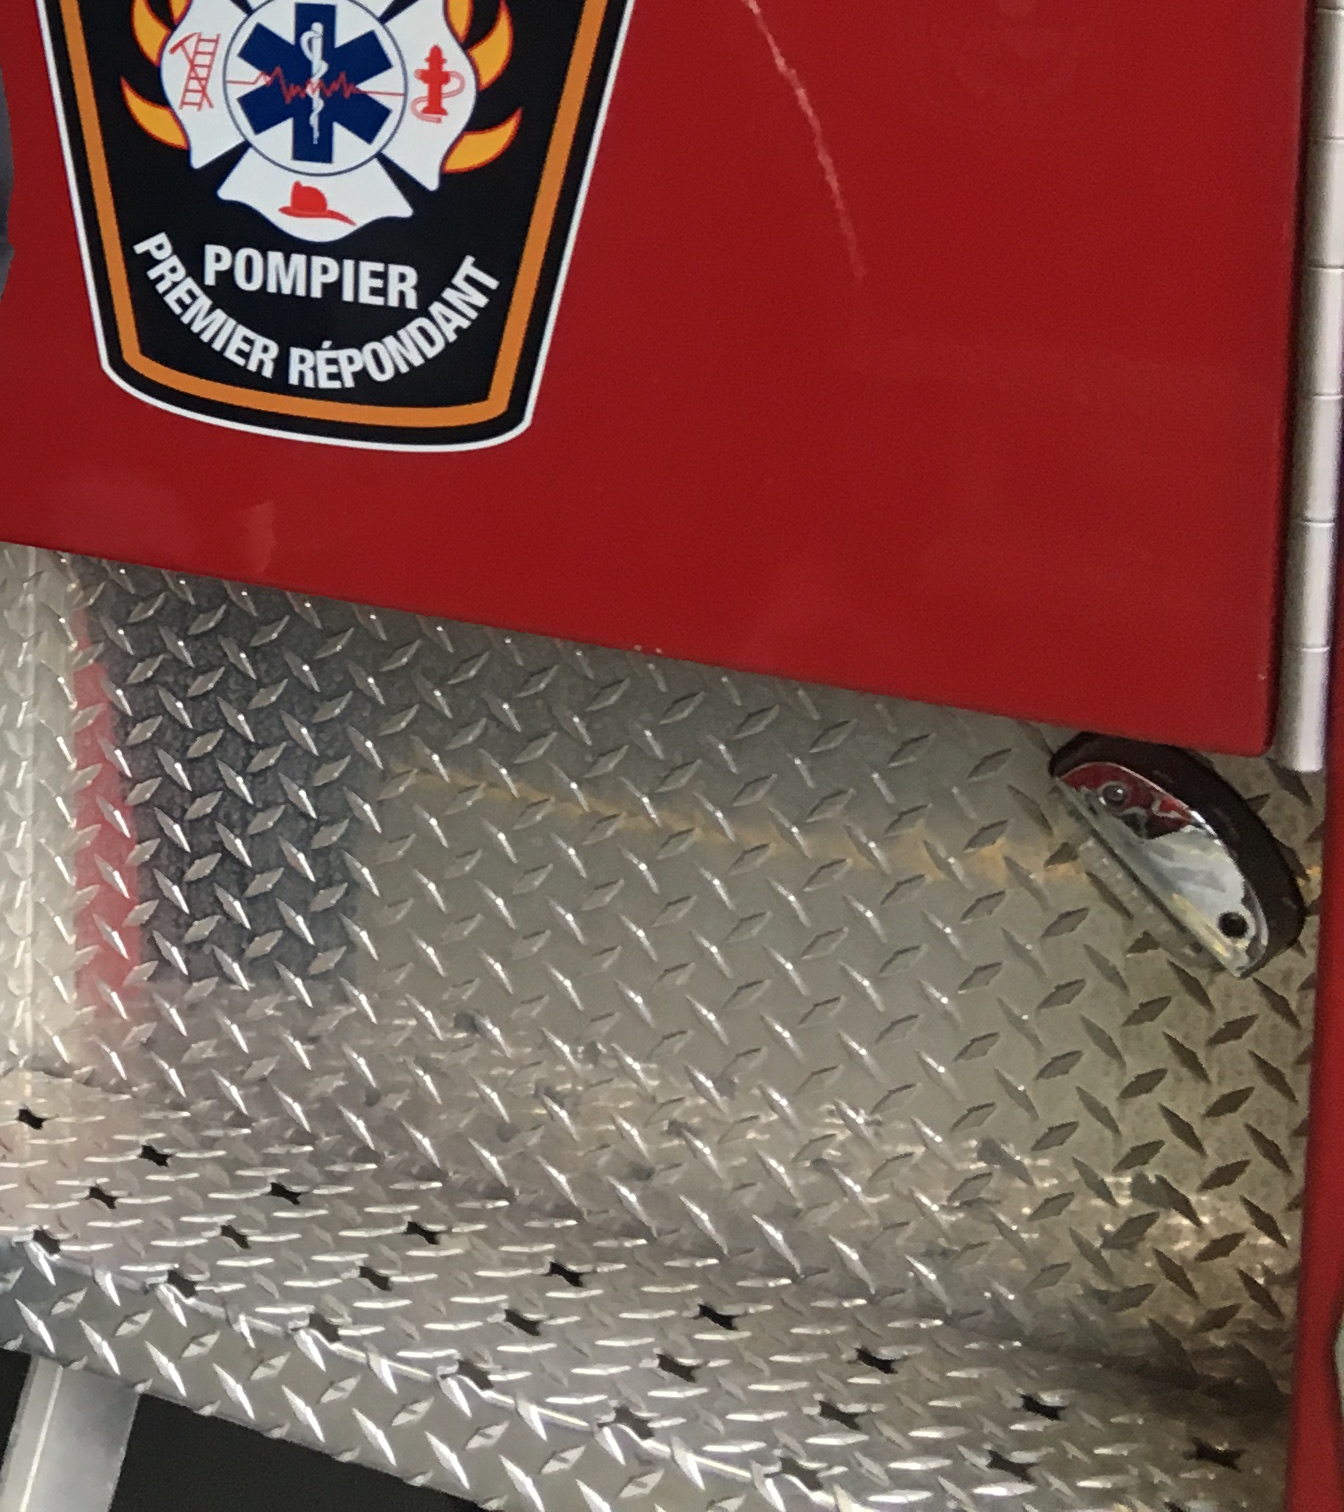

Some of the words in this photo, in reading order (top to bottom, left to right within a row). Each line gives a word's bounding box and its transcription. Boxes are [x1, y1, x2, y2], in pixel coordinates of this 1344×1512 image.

[133, 232, 278, 378] PREMIER
[289, 255, 500, 388] RÉPONDANT
[203, 244, 418, 310] POMPIER
